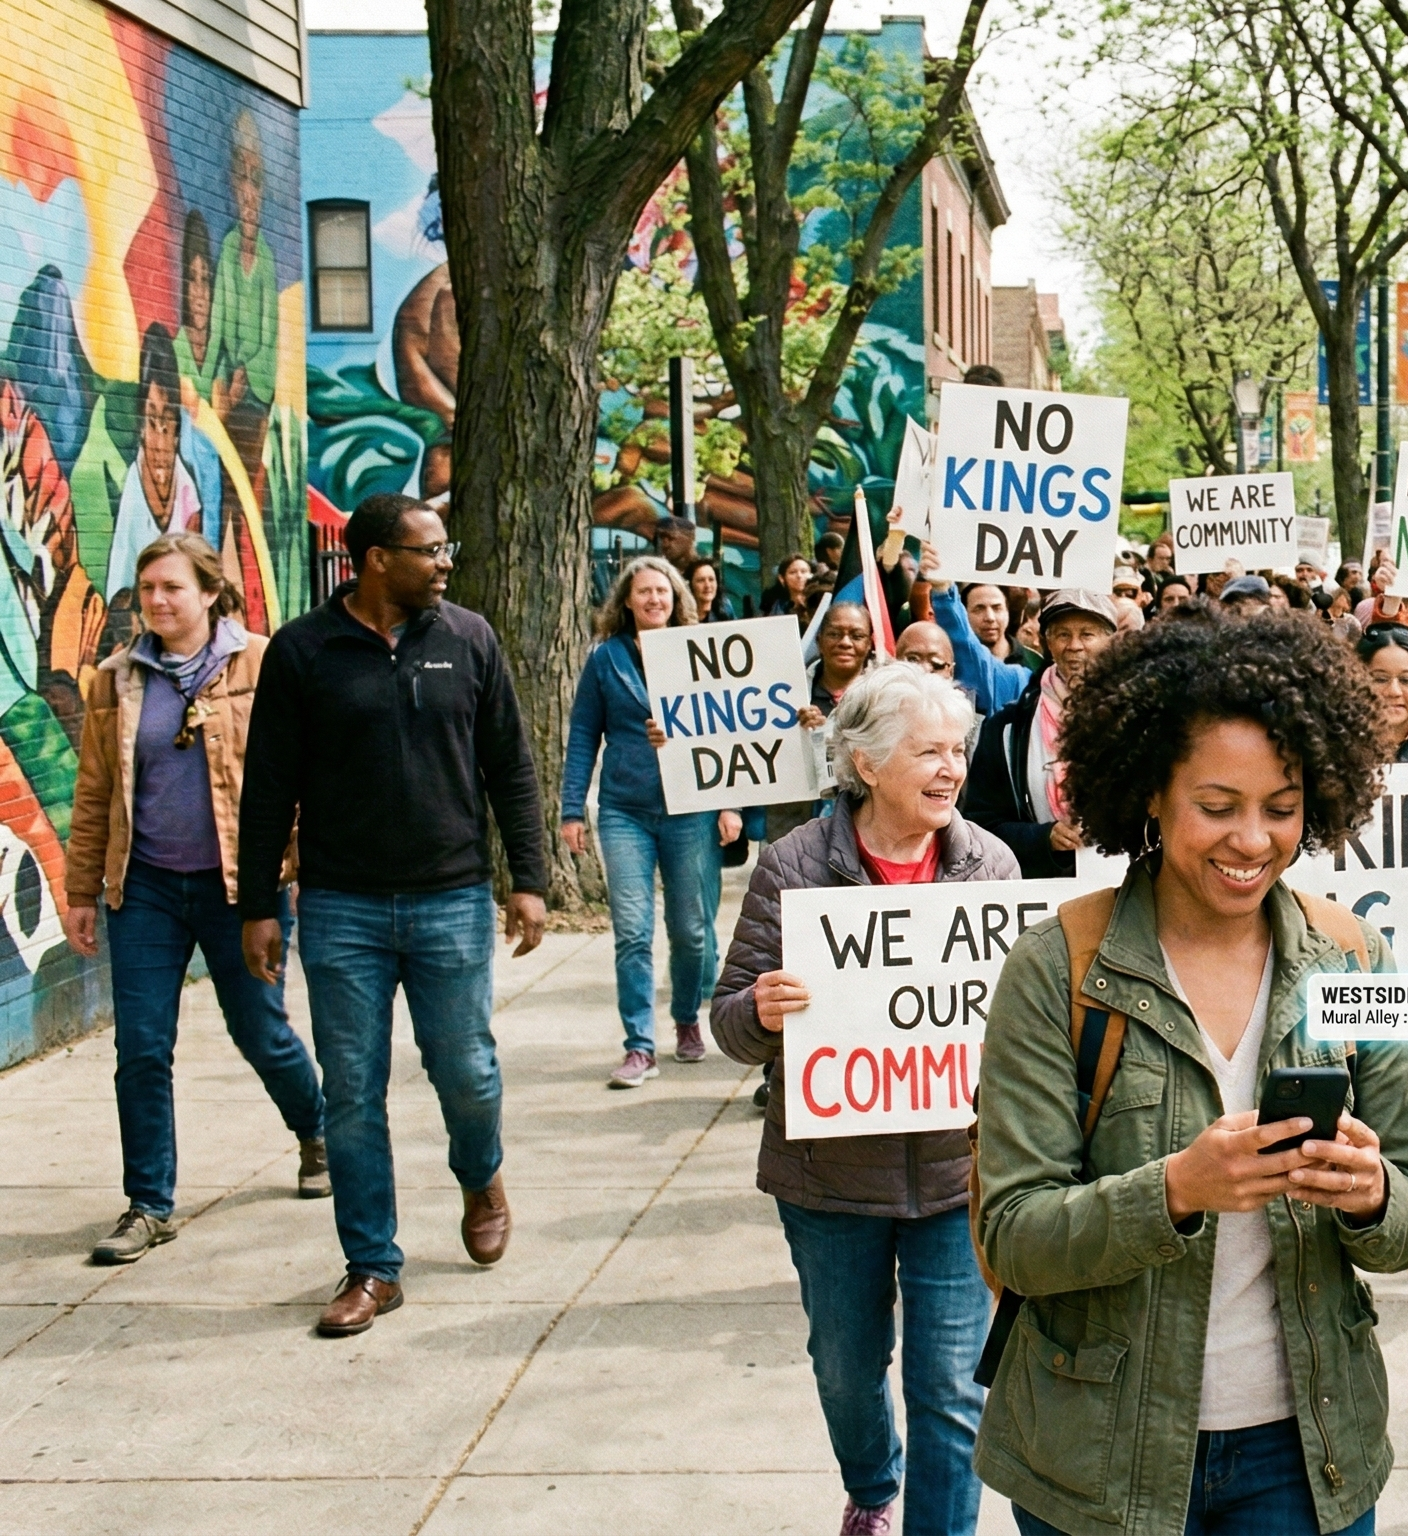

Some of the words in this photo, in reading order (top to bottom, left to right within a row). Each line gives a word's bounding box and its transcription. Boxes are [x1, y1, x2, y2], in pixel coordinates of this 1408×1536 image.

[994, 399, 1074, 455] NO
[943, 456, 1111, 522] KINGS
[1186, 487, 1220, 512] WE
[1230, 483, 1276, 510] ARE
[975, 522, 1079, 578] DAY
[1176, 516, 1294, 549] COMMUNITY
[686, 633, 754, 682] NO
[660, 682, 799, 739] KINGS
[691, 739, 783, 791] DAY
[819, 908, 913, 970] WE
[888, 979, 988, 1030] OUR
